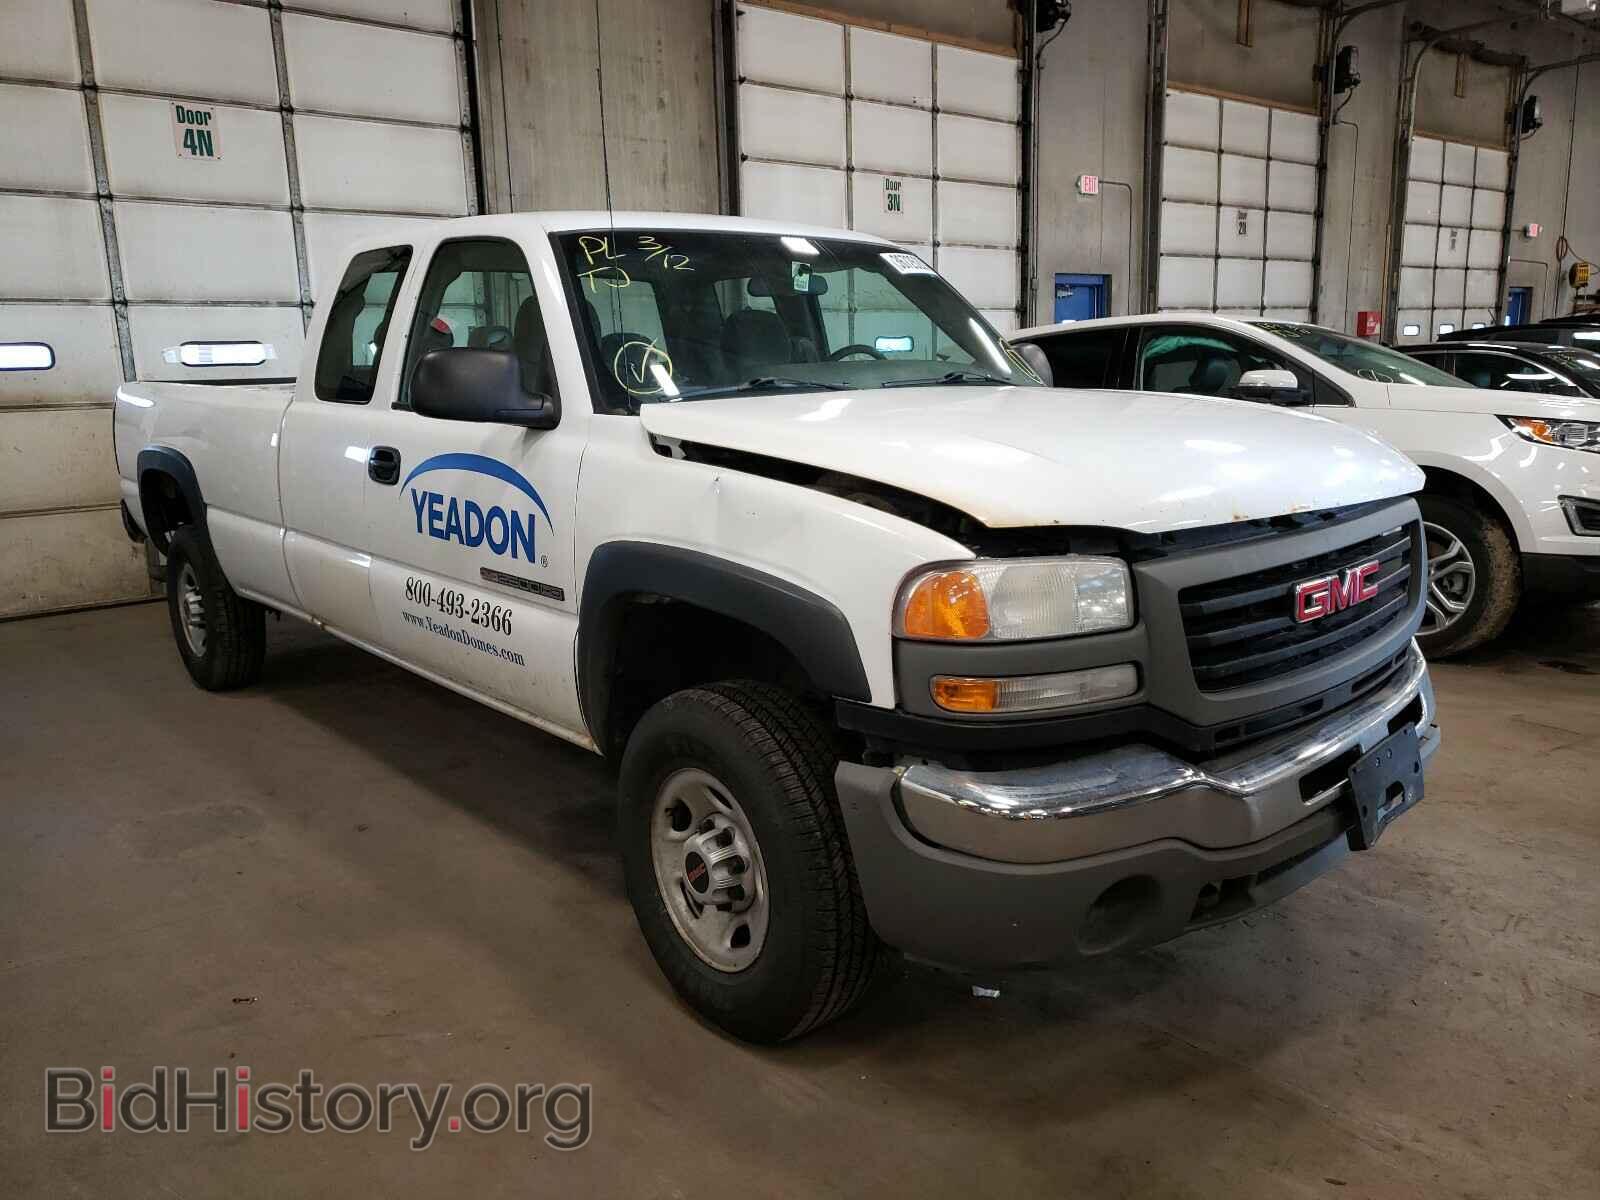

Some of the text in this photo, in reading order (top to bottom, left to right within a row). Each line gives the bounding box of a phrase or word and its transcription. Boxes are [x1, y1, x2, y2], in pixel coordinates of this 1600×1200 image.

[175, 104, 212, 126] Door
[183, 128, 214, 157] 4N
[885, 178, 902, 191] Door
[887, 193, 901, 212] 3N
[410, 487, 536, 564] YEADON
[405, 576, 513, 636] 800-493-2366
[1295, 559, 1379, 623] GMC
[402, 610, 526, 667] www.YeadonDomes.com
